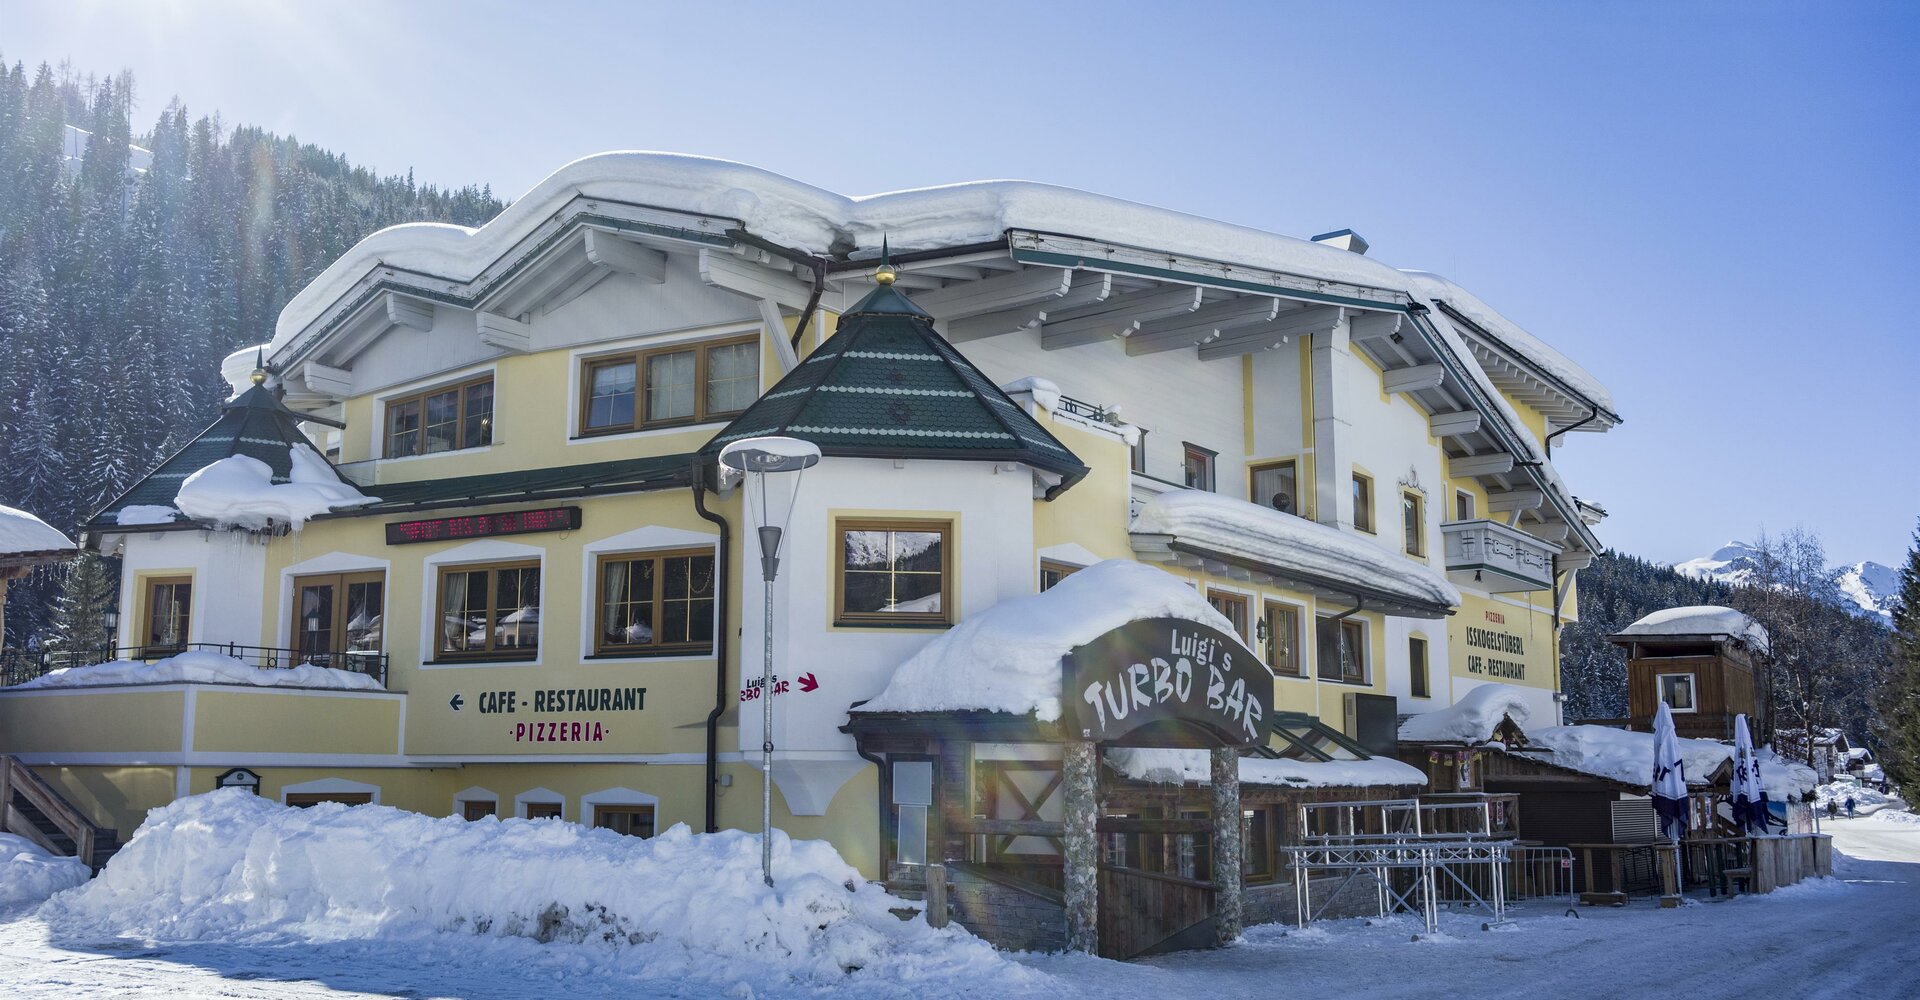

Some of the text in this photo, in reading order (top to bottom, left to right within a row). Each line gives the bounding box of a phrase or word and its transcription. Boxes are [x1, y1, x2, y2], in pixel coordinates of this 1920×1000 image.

[1485, 610, 1505, 624] PIZZERIA
[1466, 626, 1524, 655] ISSKOGELSTÜBERL
[1468, 655, 1482, 674] CAFE
[1488, 658, 1525, 680] RESTAURANT
[479, 691, 516, 713] CAFE
[534, 687, 647, 712] RESTAURANT
[1083, 657, 1263, 740] TURBO BAR
